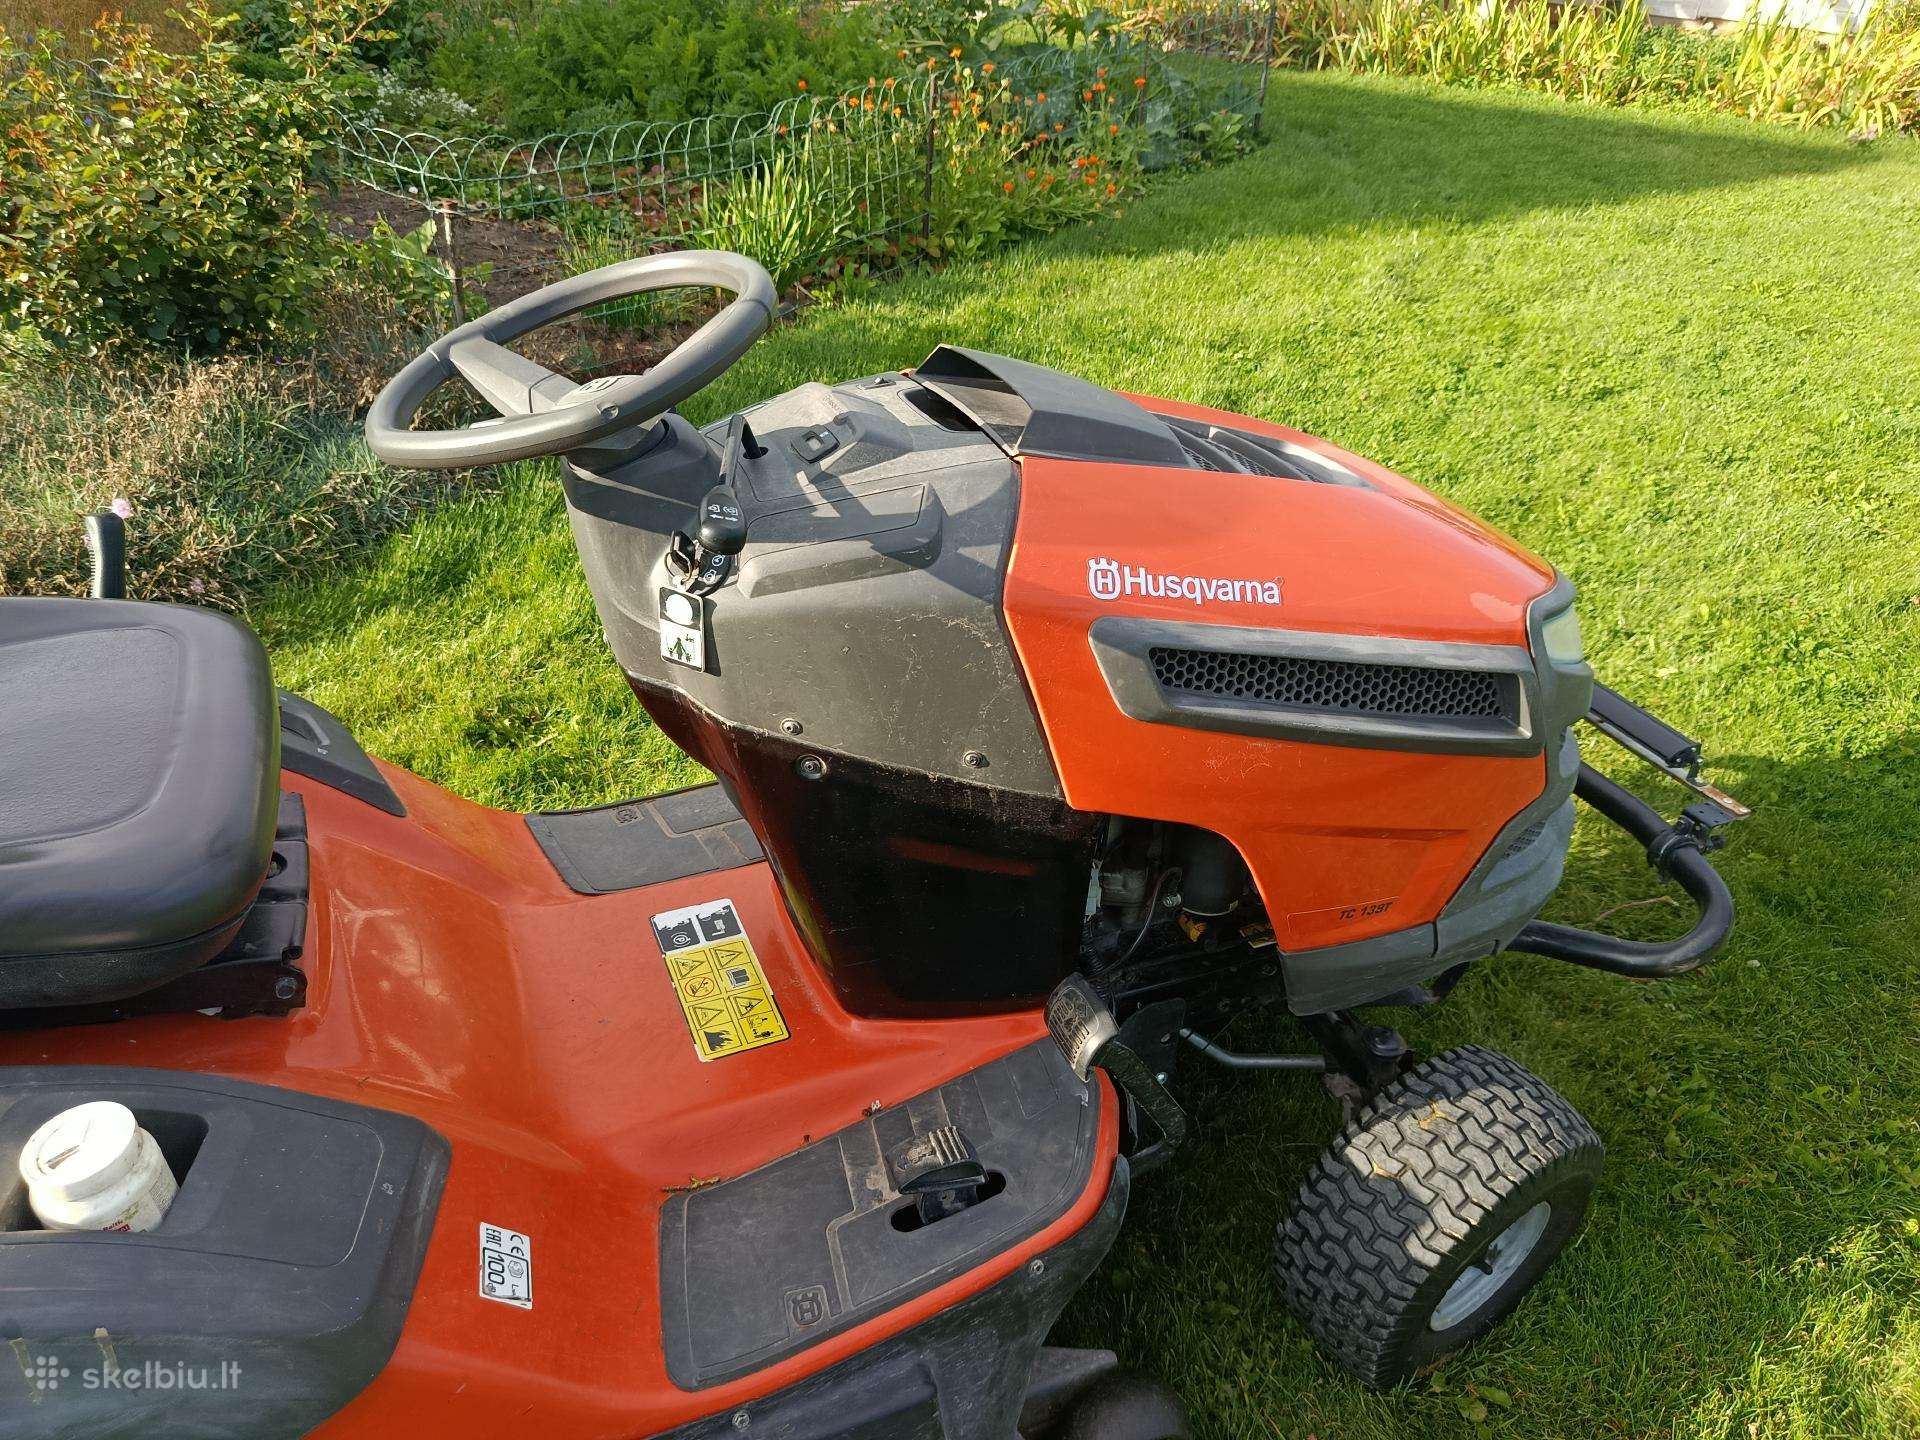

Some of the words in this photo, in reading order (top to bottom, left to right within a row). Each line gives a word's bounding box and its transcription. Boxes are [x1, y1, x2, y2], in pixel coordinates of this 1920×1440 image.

[1122, 564, 1281, 605] Husqvarna
[1339, 908, 1356, 921] TC
[487, 1254, 505, 1285] 100
